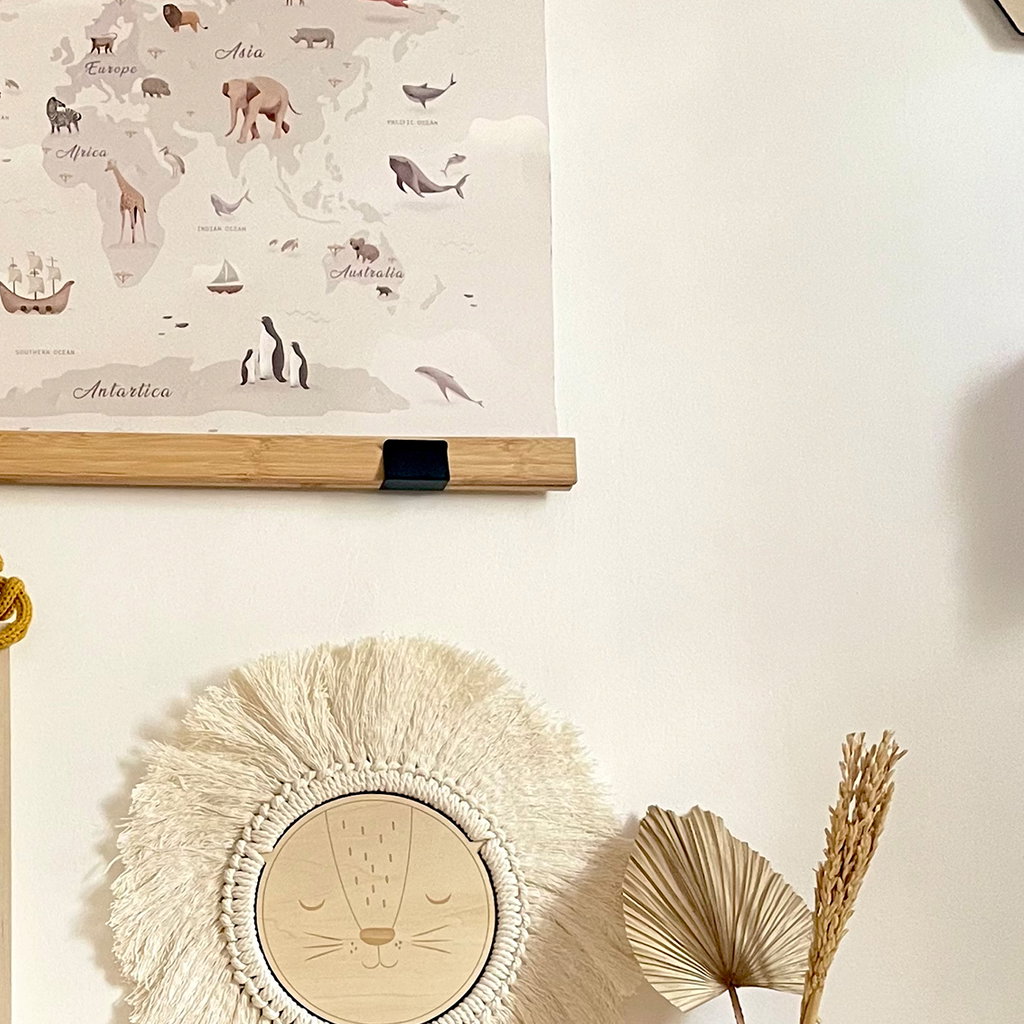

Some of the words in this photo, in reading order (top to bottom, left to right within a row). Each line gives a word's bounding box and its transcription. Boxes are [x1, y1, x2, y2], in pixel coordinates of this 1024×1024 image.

[215, 42, 265, 60] Asia
[85, 61, 138, 77] Europe
[56, 144, 108, 161] Africa
[330, 264, 405, 279] Australia
[72, 379, 173, 399] Antartica
